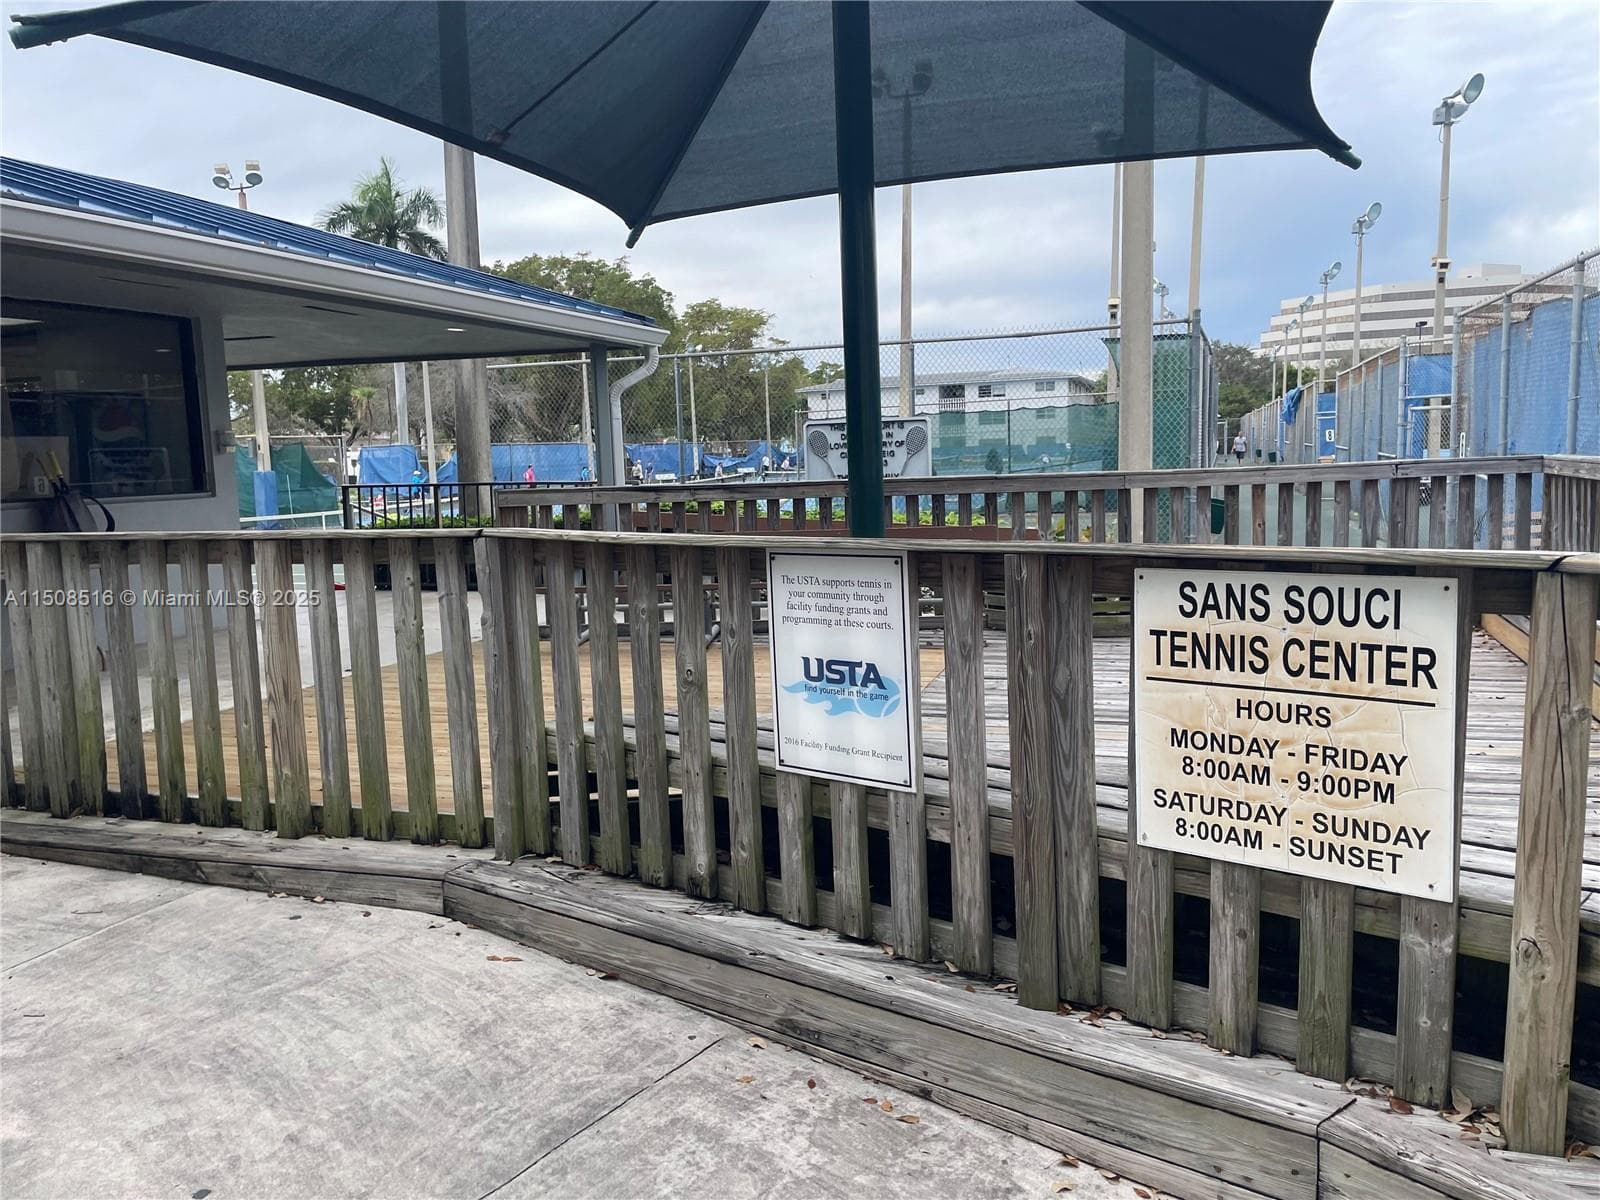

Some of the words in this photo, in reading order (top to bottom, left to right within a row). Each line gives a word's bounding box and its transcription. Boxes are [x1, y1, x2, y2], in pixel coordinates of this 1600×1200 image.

[894, 440, 905, 448] OF
[781, 575, 795, 585] The
[797, 575, 820, 586] USTA
[822, 578, 855, 589] supports
[857, 579, 882, 589] tennis
[884, 579, 892, 589] in
[788, 590, 805, 599] your
[807, 591, 851, 602] community
[853, 592, 885, 604] through
[786, 601, 812, 613] facility
[814, 602, 843, 616] funding
[846, 606, 871, 616] grants
[872, 607, 888, 616] and
[1179, 581, 1271, 622] SANS
[1283, 585, 1401, 630] SOUCI
[782, 615, 832, 628] programming
[834, 618, 842, 626] at
[843, 618, 864, 628] these
[866, 621, 894, 630] courts.
[801, 656, 887, 690] USTA
[1149, 629, 1269, 675] TENNIS
[1282, 638, 1438, 690] CENTER
[804, 683, 817, 693] find
[819, 686, 845, 696] yourself
[848, 688, 854, 697] in
[856, 689, 867, 699] the
[869, 693, 889, 702] game
[1236, 698, 1332, 728] HOURS
[784, 736, 800, 746] 2016
[800, 739, 823, 751] Facility
[824, 743, 851, 755] Funding
[851, 746, 870, 757] Grant
[871, 749, 903, 762] Recipient
[1170, 728, 1280, 759] MONDAY
[1305, 744, 1408, 776] FRIDAY
[1182, 756, 1271, 786] 8:00AM
[1297, 771, 1395, 804] 9:00PM
[1153, 789, 1288, 827] SATURDAY
[1312, 813, 1432, 850] SUNDAY
[1175, 818, 1263, 850] 8:00AM
[1289, 836, 1403, 874] SUNSET
